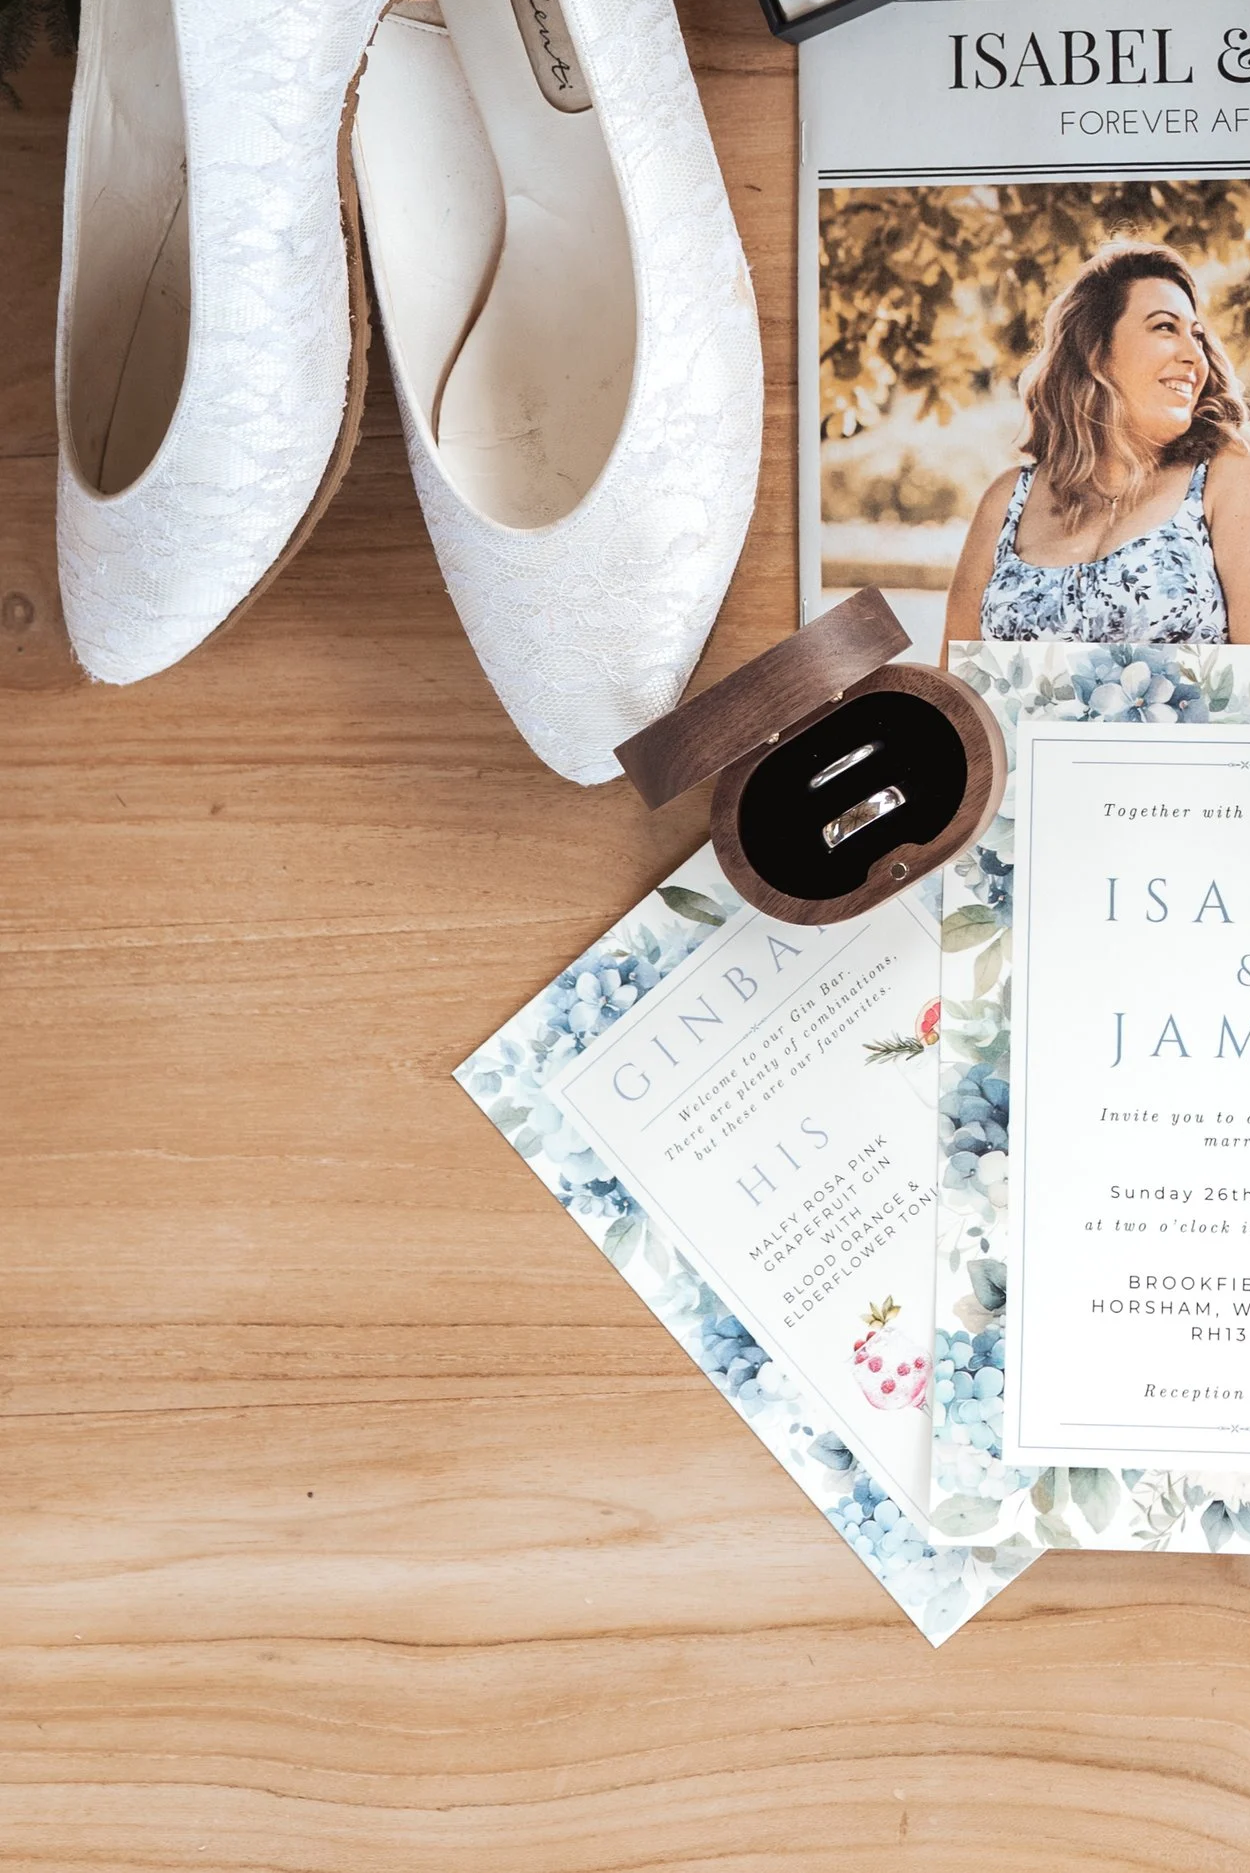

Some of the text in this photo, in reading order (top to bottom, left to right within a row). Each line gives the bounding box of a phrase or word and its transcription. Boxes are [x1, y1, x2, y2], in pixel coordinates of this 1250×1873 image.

[949, 29, 1193, 89] ISABEL
[1062, 109, 1198, 135] FOREVER
[1103, 803, 1191, 821] Together
[1202, 804, 1243, 819] with
[612, 925, 827, 1102] GINBA
[677, 970, 851, 1122] Welcome to our Gin Bar.
[692, 986, 892, 1161] but these are our favourites.
[663, 1124, 705, 1161] There
[709, 1099, 732, 1123] are
[735, 1057, 779, 1101] plenty
[783, 1035, 798, 1056] of
[1100, 1107, 1159, 1123] Invite
[1171, 1113, 1204, 1127] you
[1216, 1111, 1234, 1124] to
[734, 1115, 829, 1207] HIS
[747, 1134, 887, 1261] MALFY ROSA PINK
[762, 1155, 891, 1272] GRAPEFRUIT GIN
[818, 1205, 862, 1244] WITH
[1110, 1185, 1193, 1204] Sunday
[781, 1180, 920, 1304] BLOOD ORANGE &
[782, 1181, 940, 1328] ELDERFLOWER TONI
[1084, 1219, 1102, 1231] at
[1114, 1219, 1147, 1232] two
[1159, 1218, 1230, 1234] o'clock
[1092, 1299, 1219, 1318] HORSHAM,
[1191, 1326, 1246, 1342] RH13
[1144, 1383, 1243, 1402] Reception
